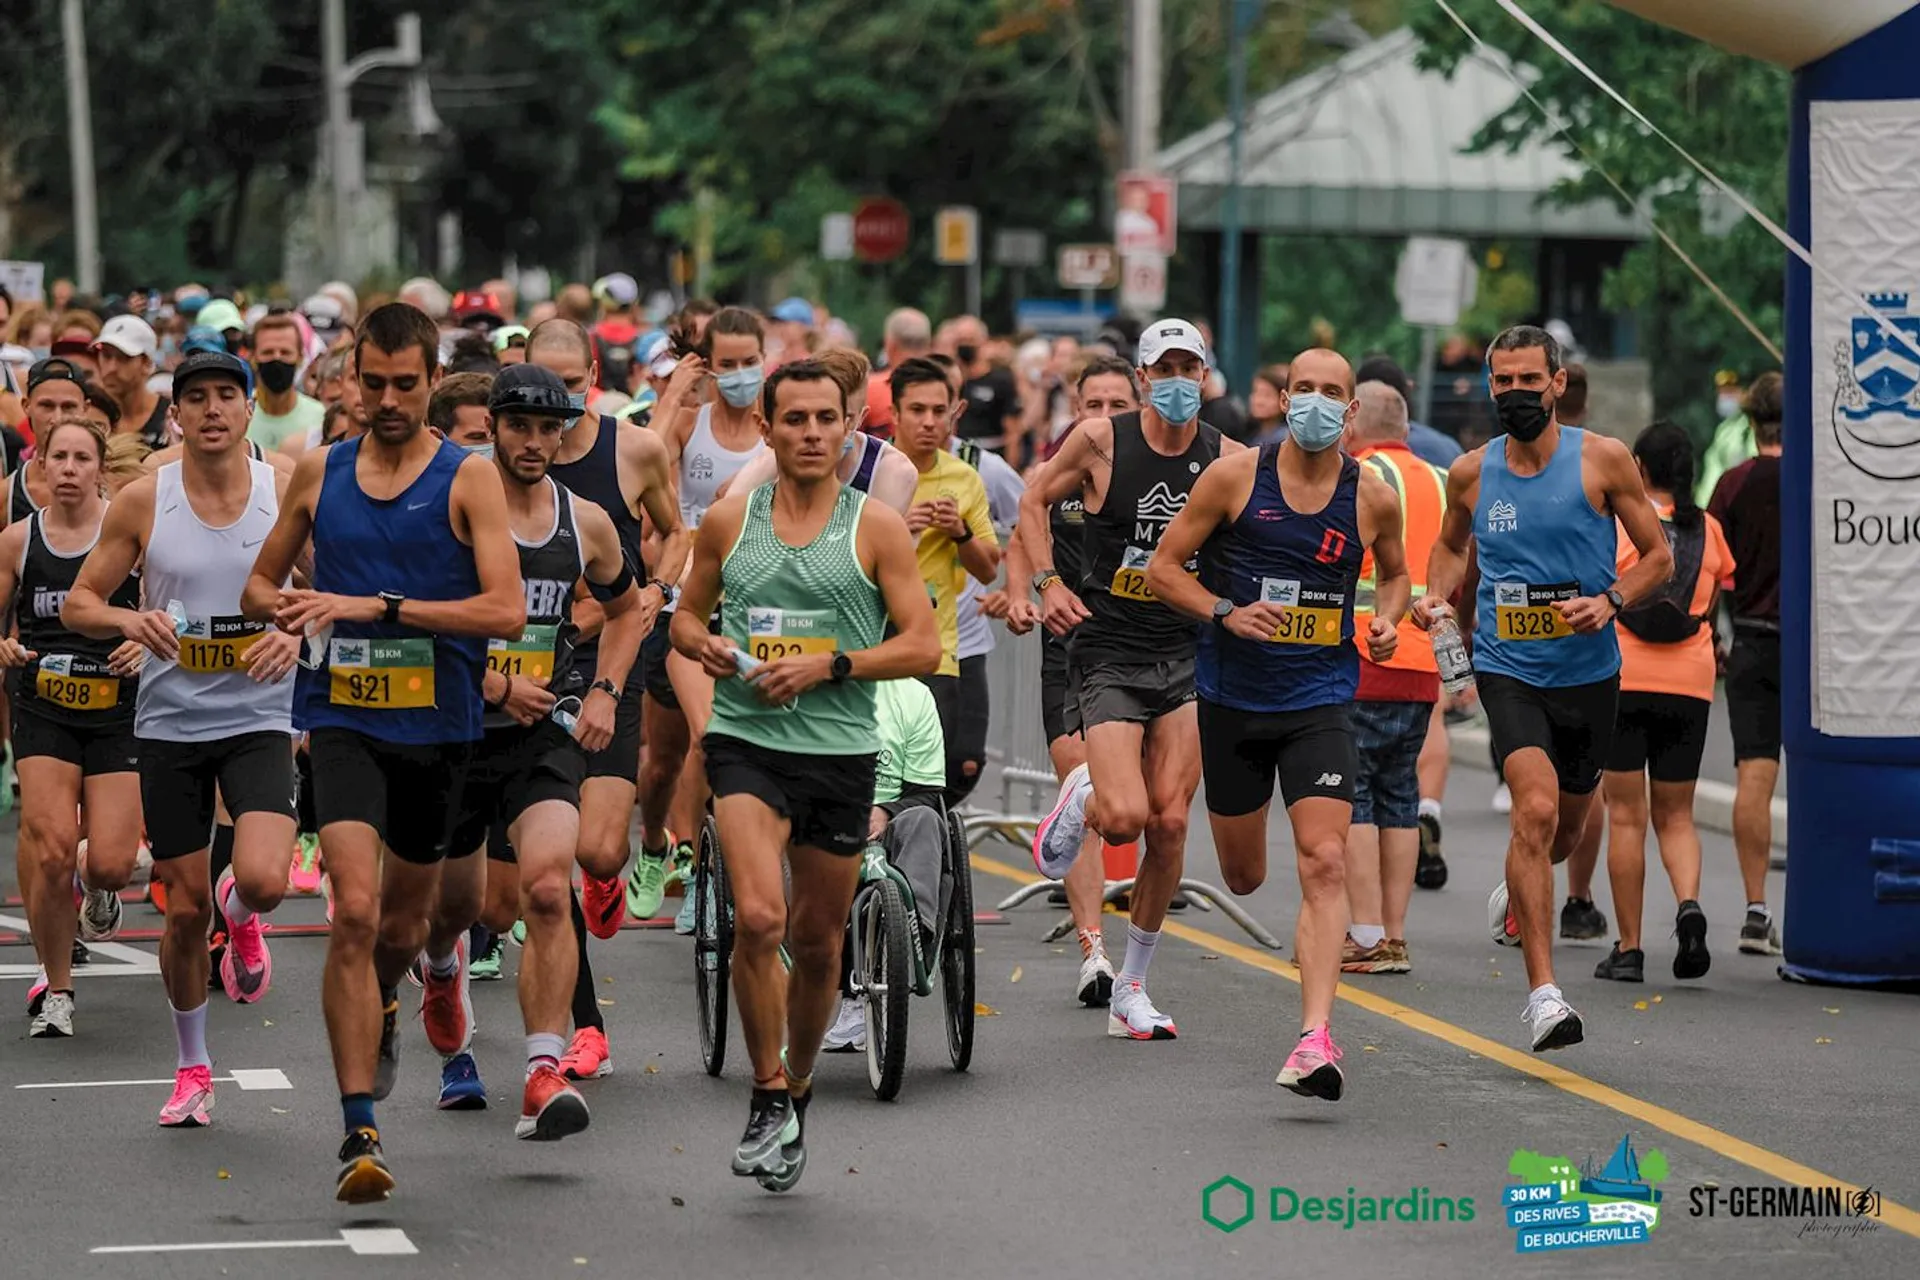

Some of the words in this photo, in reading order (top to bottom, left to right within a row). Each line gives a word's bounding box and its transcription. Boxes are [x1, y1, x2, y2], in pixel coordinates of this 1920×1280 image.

[1488, 521, 1517, 533] M2M
[1314, 591, 1327, 601] KM
[226, 622, 242, 631] KM
[798, 619, 813, 628] KM
[1505, 611, 1555, 635] 1328
[188, 643, 234, 668] 1176
[386, 649, 401, 659] KM
[44, 678, 91, 706] 1298
[350, 674, 390, 703] 921
